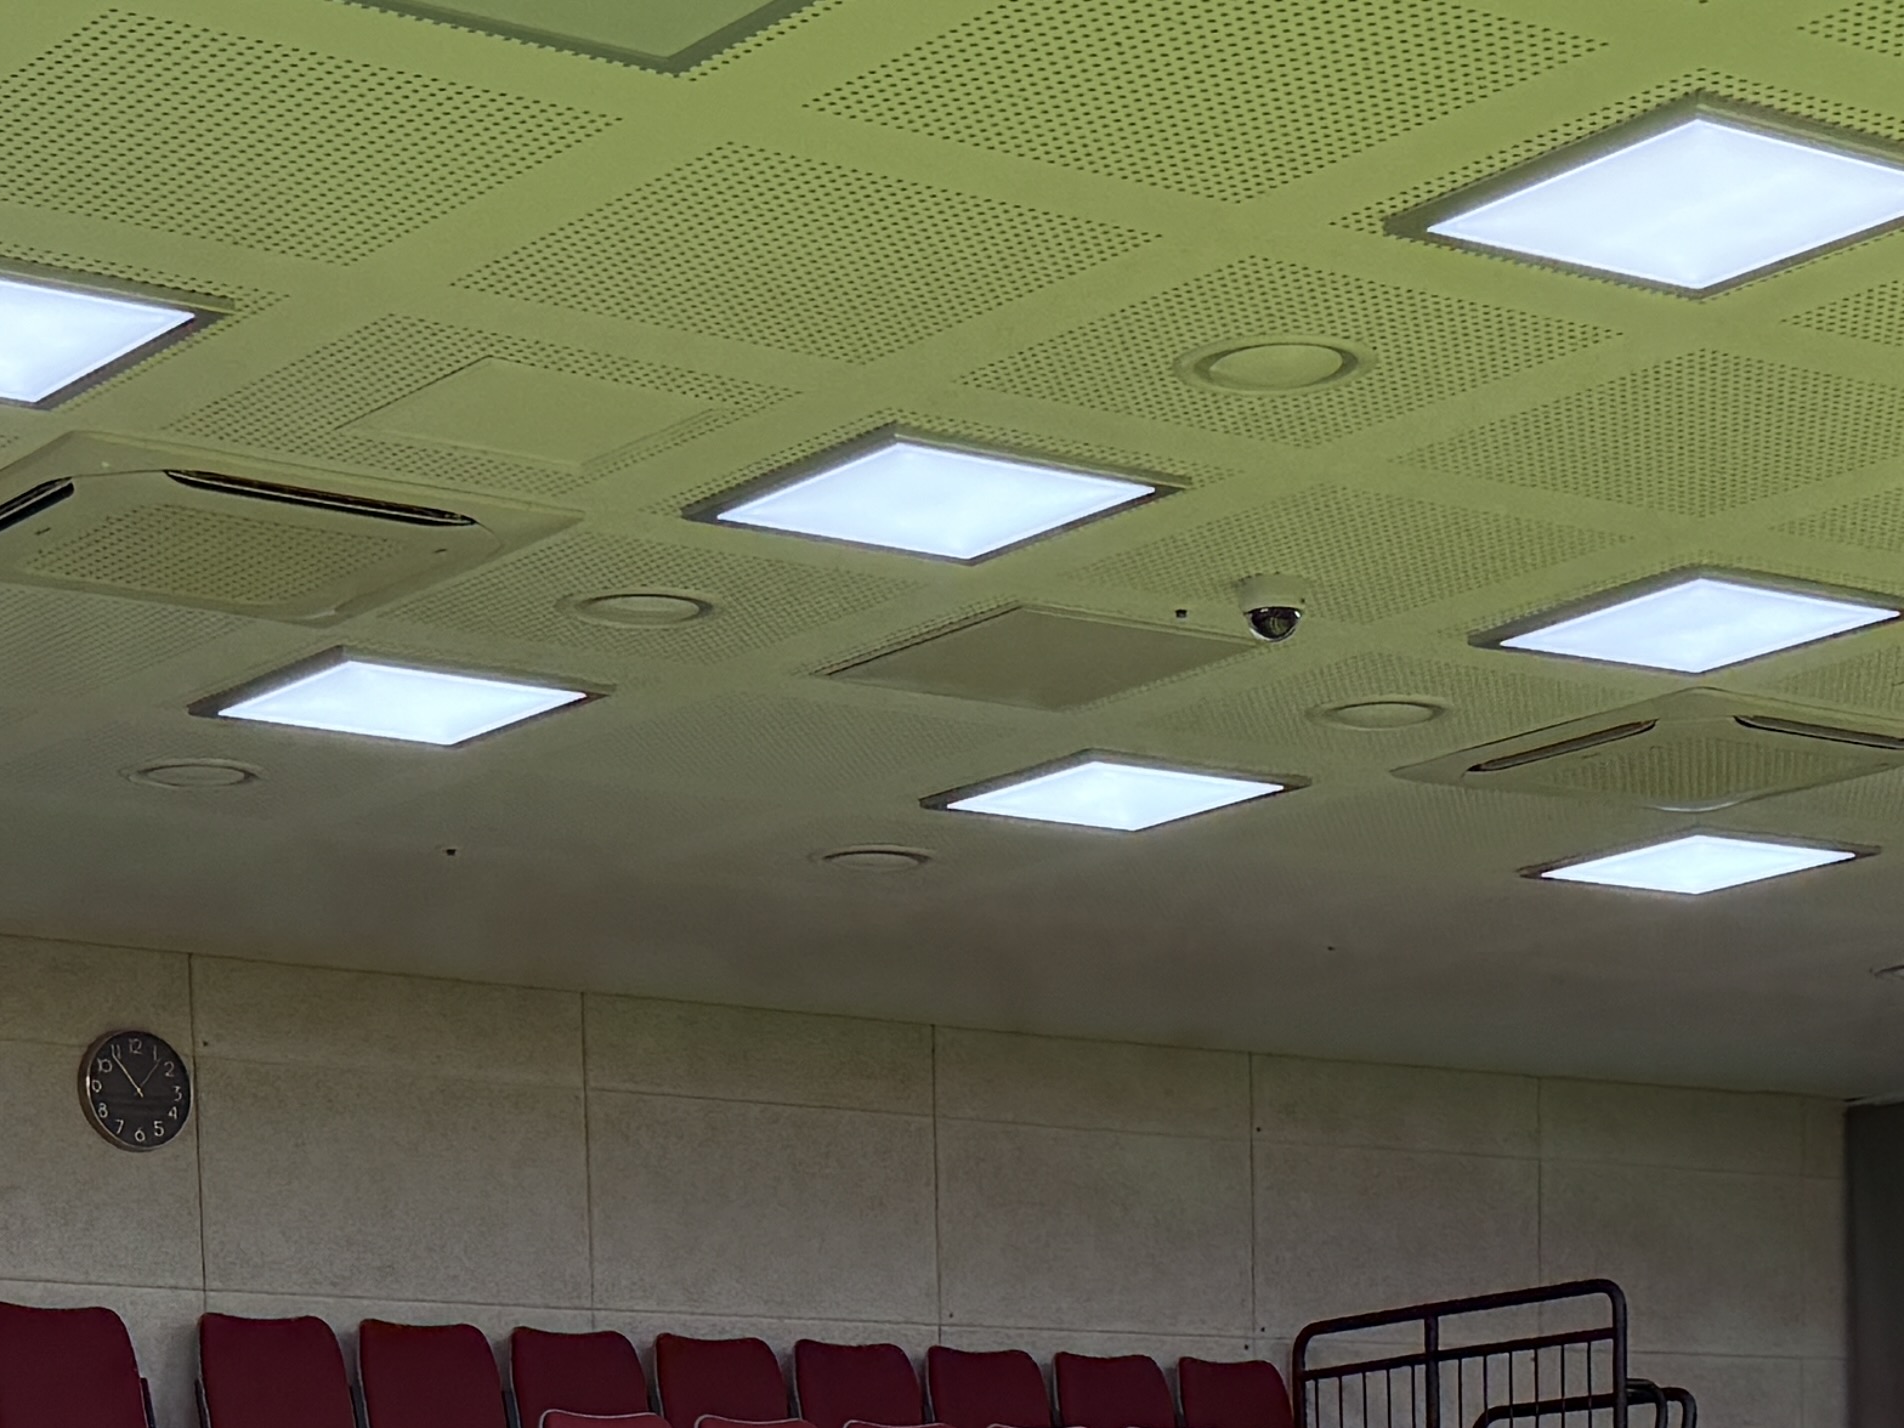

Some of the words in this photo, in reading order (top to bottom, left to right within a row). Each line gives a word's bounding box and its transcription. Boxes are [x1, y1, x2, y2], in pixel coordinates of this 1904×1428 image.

[129, 1038, 143, 1055] 12
[97, 1058, 113, 1073] 10
[164, 1061, 175, 1077] 2
[173, 1085, 183, 1102] 3
[98, 1102, 108, 1118] 8
[168, 1106, 178, 1120] 4
[115, 1119, 124, 1135] 7
[134, 1127, 146, 1142] 6
[153, 1121, 165, 1137] 5
